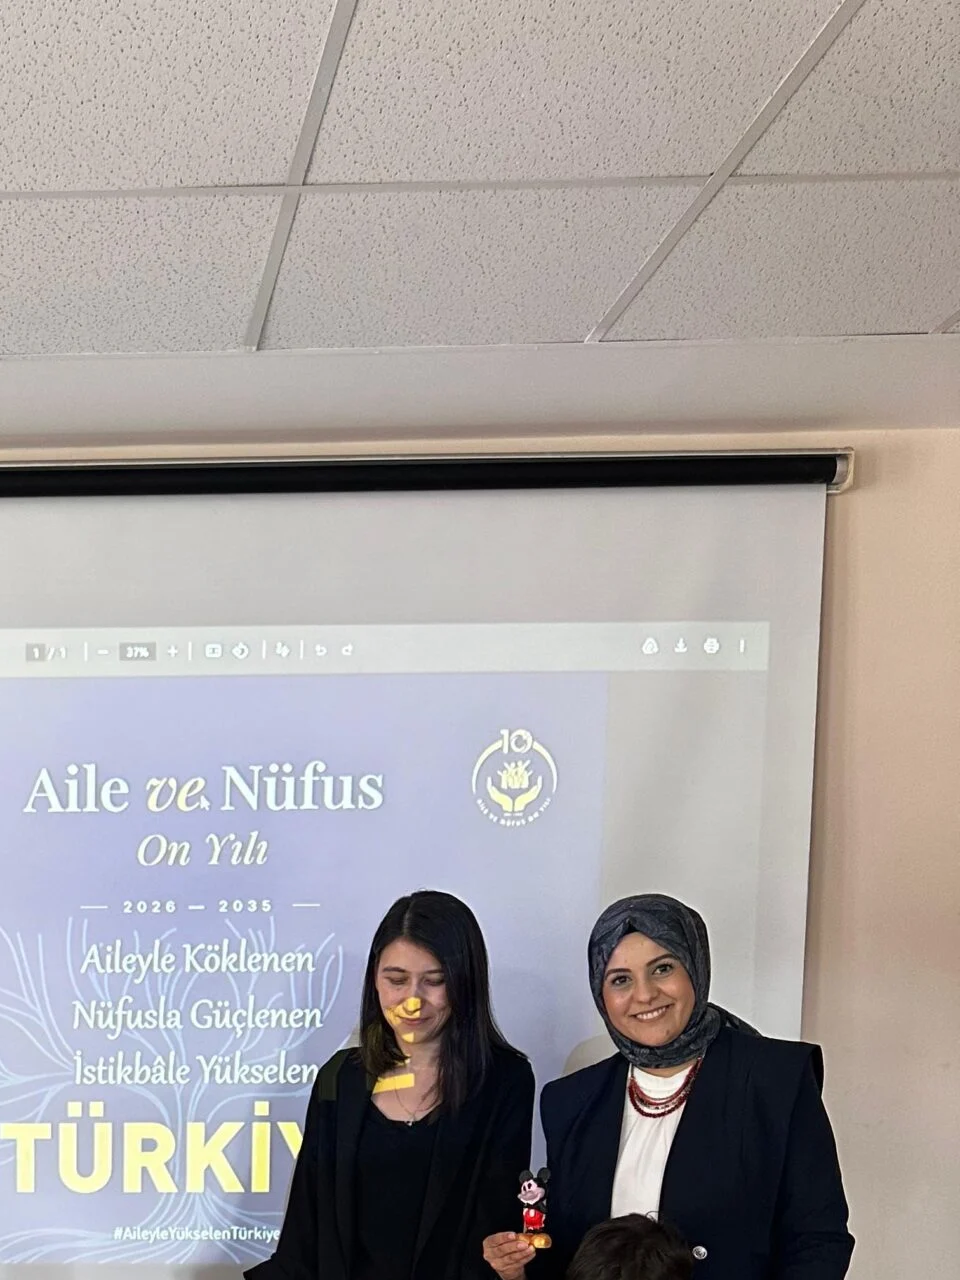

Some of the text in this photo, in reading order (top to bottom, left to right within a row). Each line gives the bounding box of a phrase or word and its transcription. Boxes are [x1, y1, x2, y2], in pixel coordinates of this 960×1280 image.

[23, 760, 384, 814] Aile ve Nüfus
[137, 830, 269, 866] On Yılı
[123, 900, 177, 914] 2026
[218, 899, 272, 913] 2035
[80, 938, 316, 984] Aileyle Köklenen
[72, 995, 324, 1040] Nüfusla Güçlenen
[73, 1050, 319, 1085] İstikbâle Yükselen
[113, 1225, 281, 1244] #AileyleYükselenTürkiye
